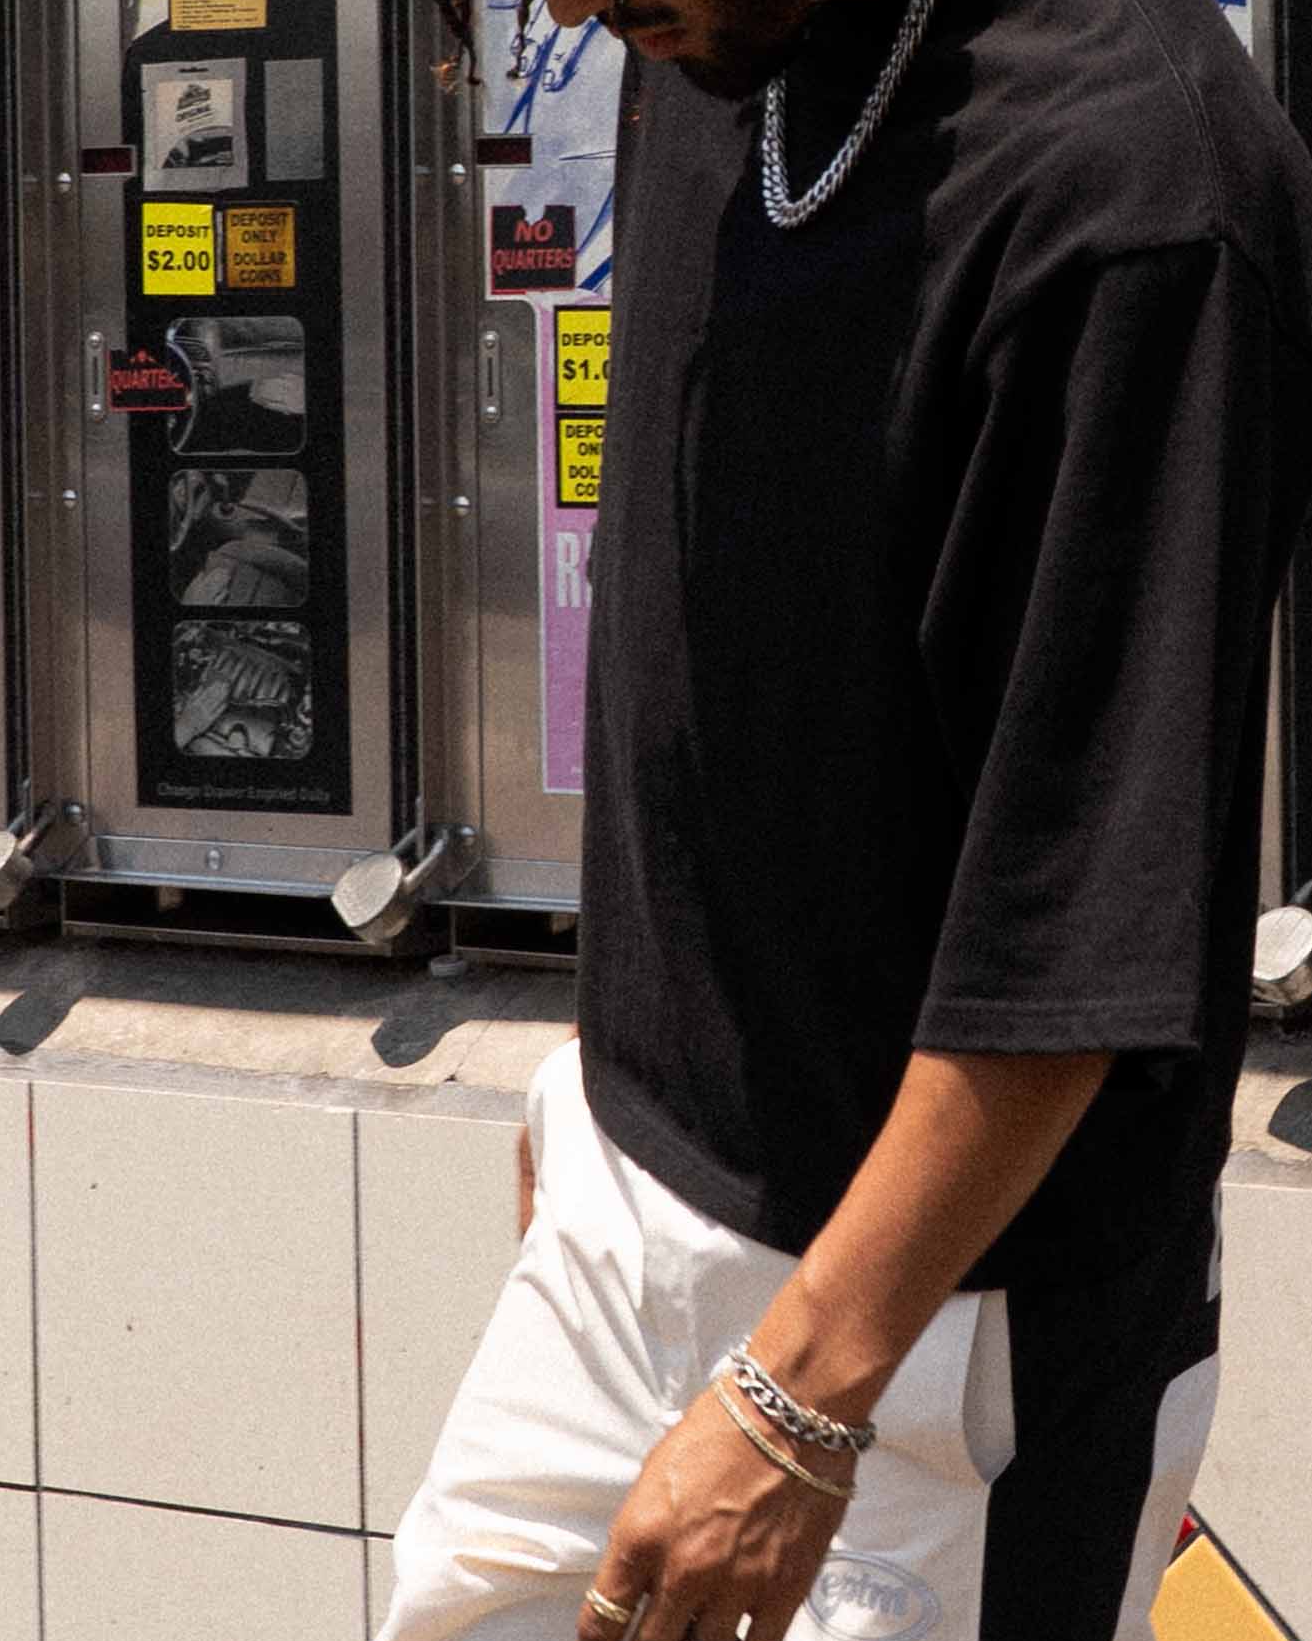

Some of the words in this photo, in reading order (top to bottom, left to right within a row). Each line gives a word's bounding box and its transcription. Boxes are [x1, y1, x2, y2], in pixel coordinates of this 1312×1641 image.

[231, 213, 288, 227] DEPOSIT
[146, 225, 210, 238] DEPOSIT
[242, 231, 279, 244] ONLY
[514, 219, 555, 243] NO
[147, 249, 210, 272] $2.00
[234, 252, 287, 266] DOLLAR
[491, 248, 575, 275] QUARTERS
[239, 269, 281, 283] COINS
[562, 359, 611, 381] $1.0
[565, 424, 606, 439] DEPO
[568, 464, 600, 479] DOL
